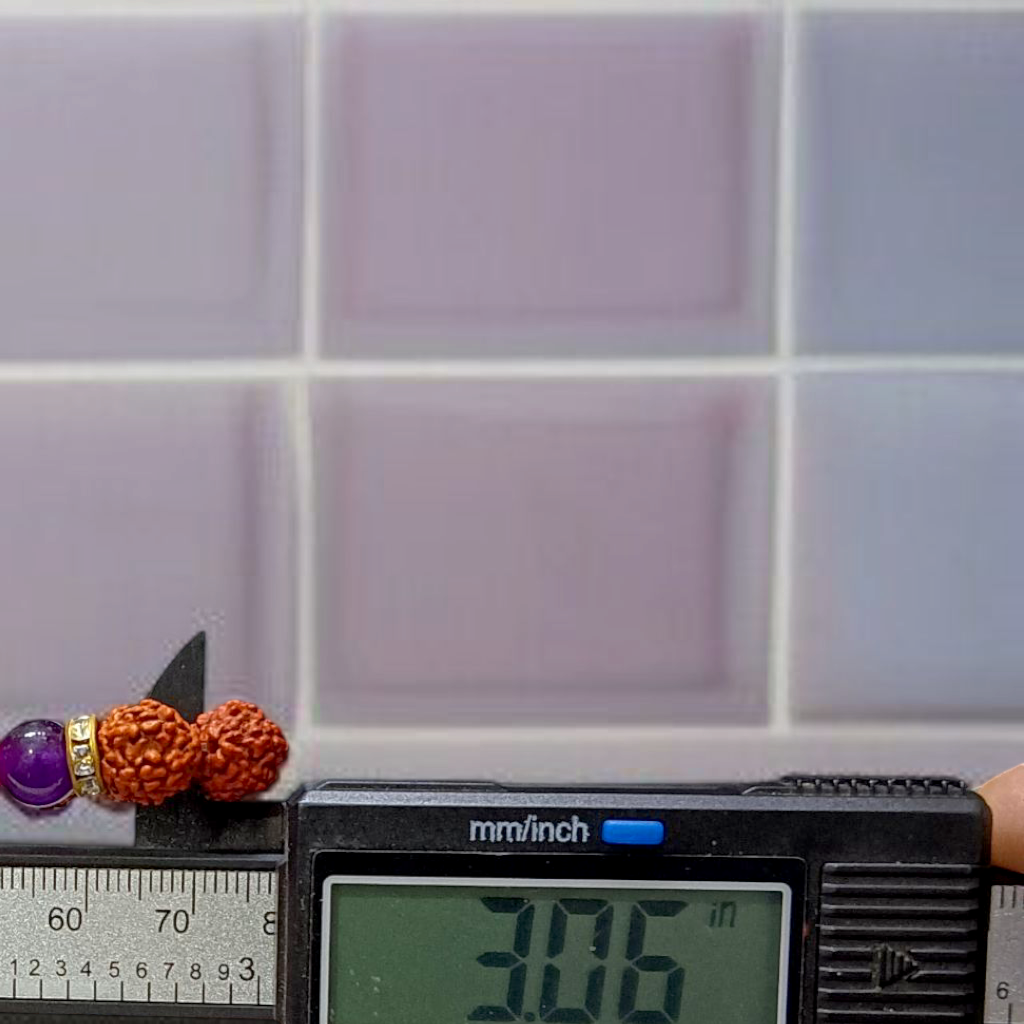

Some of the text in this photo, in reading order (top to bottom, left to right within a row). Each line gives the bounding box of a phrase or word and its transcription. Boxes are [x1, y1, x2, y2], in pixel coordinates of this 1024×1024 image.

[469, 815, 589, 843] mm/inch
[49, 908, 82, 930] 60
[155, 910, 189, 933] 70
[709, 899, 736, 928] in
[11, 960, 18, 975] 1
[30, 960, 40, 976] 2
[56, 961, 67, 976] 3
[80, 961, 92, 976] 4
[109, 962, 120, 977] 5
[136, 962, 147, 977] 6
[163, 963, 174, 978] 7
[190, 963, 201, 979] 8
[218, 964, 229, 979] 9
[239, 958, 255, 981] 3
[997, 982, 1009, 999] 6
